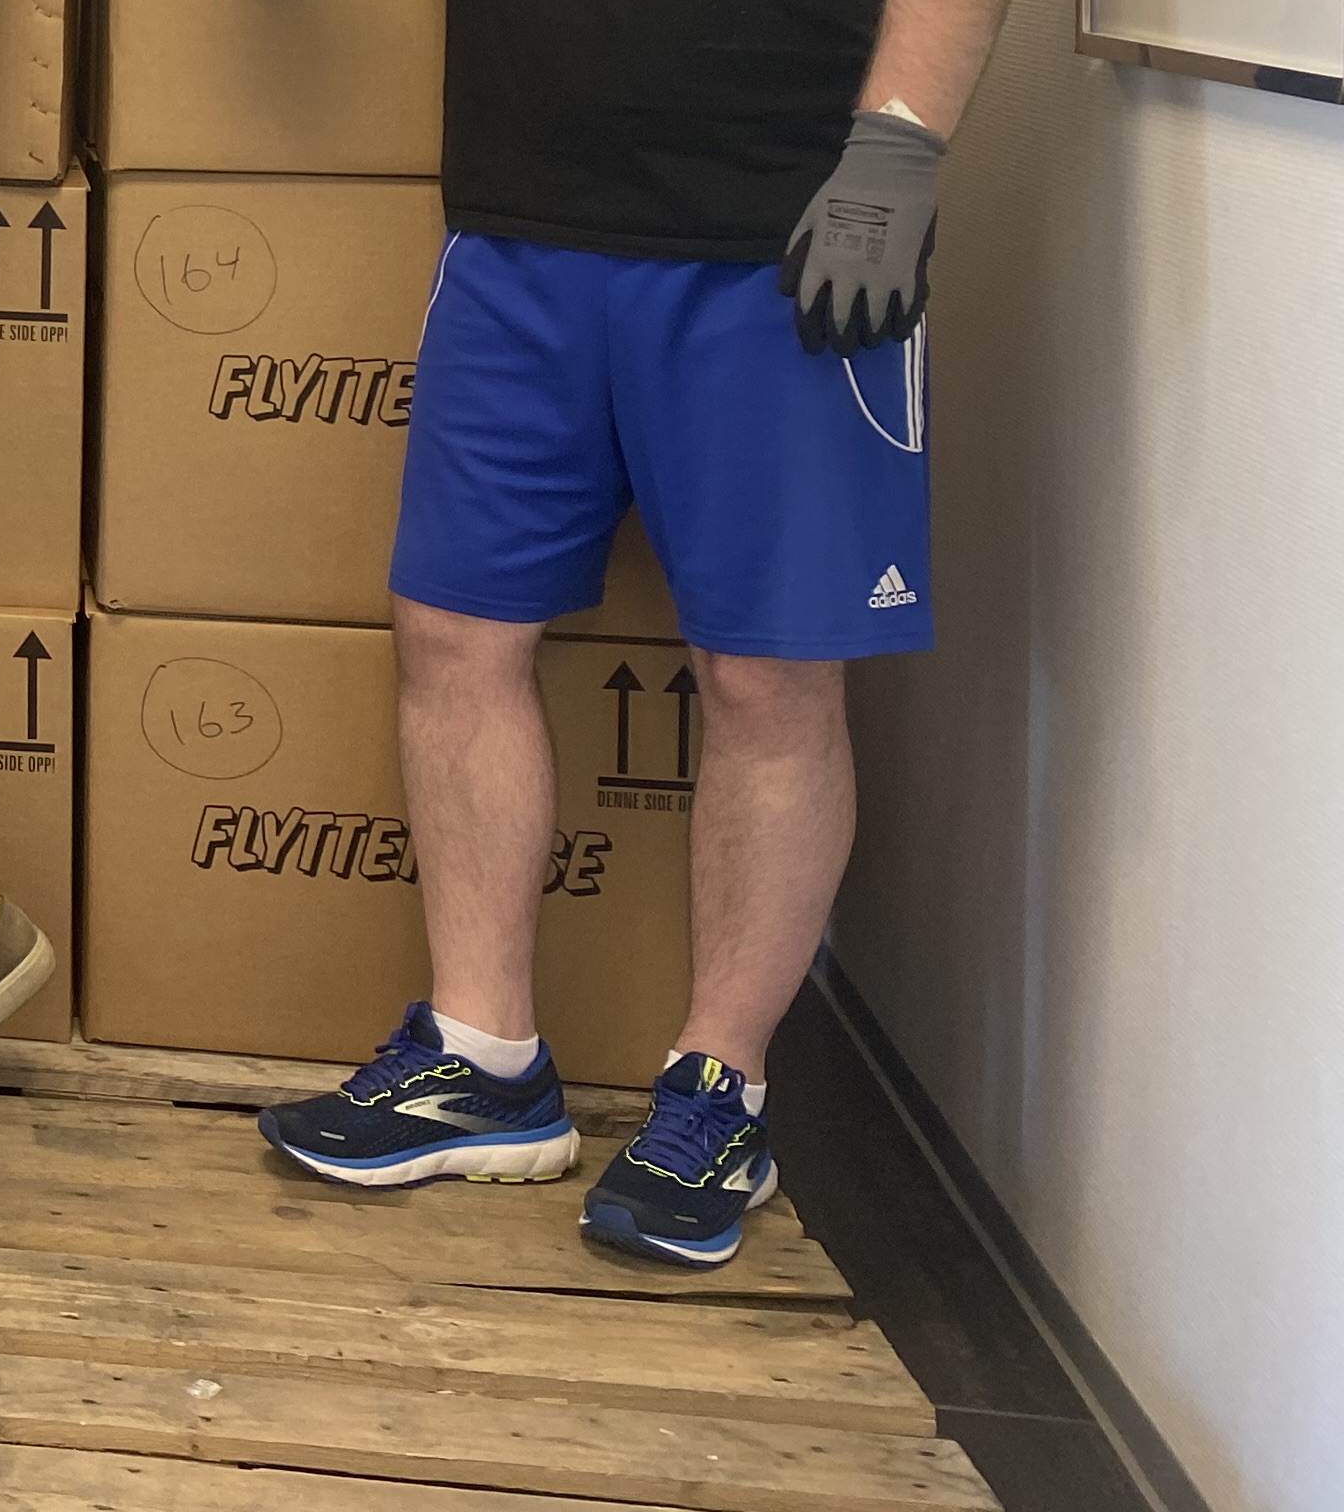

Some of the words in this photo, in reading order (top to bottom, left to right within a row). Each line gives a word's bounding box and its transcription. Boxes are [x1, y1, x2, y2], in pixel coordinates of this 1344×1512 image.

[160, 246, 240, 305] 164
[9, 324, 37, 342] SIDE
[41, 325, 68, 344] OPP!
[209, 353, 417, 427] FLYTTE
[868, 590, 917, 609] adidas
[170, 701, 253, 745] 163
[28, 755, 55, 774] OPP!
[597, 790, 639, 810] DENNE
[644, 792, 673, 812] SIDE
